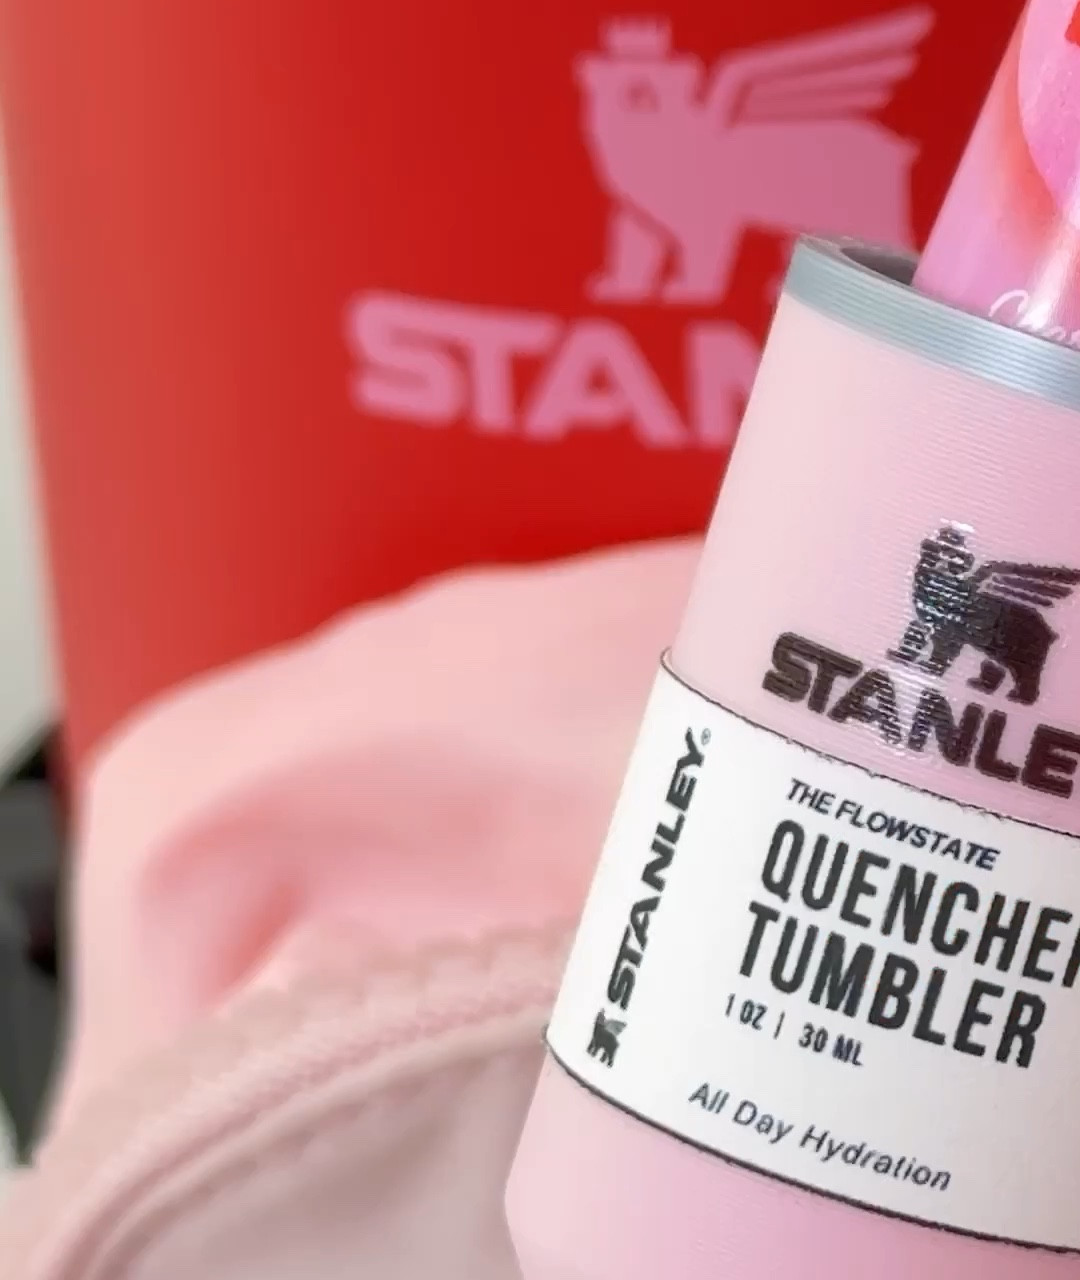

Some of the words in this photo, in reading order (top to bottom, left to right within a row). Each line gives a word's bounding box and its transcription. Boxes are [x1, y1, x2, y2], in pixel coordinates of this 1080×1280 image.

[787, 778, 834, 815] THE
[835, 798, 1000, 871] FLOWSTATE
[738, 901, 1048, 1069] TUMBLER
[739, 999, 767, 1030] OZ
[799, 1022, 828, 1053] 30
[832, 1033, 863, 1067] ML
[688, 1082, 729, 1114] All
[732, 1099, 794, 1145] Day
[800, 1124, 951, 1191] Hydration
